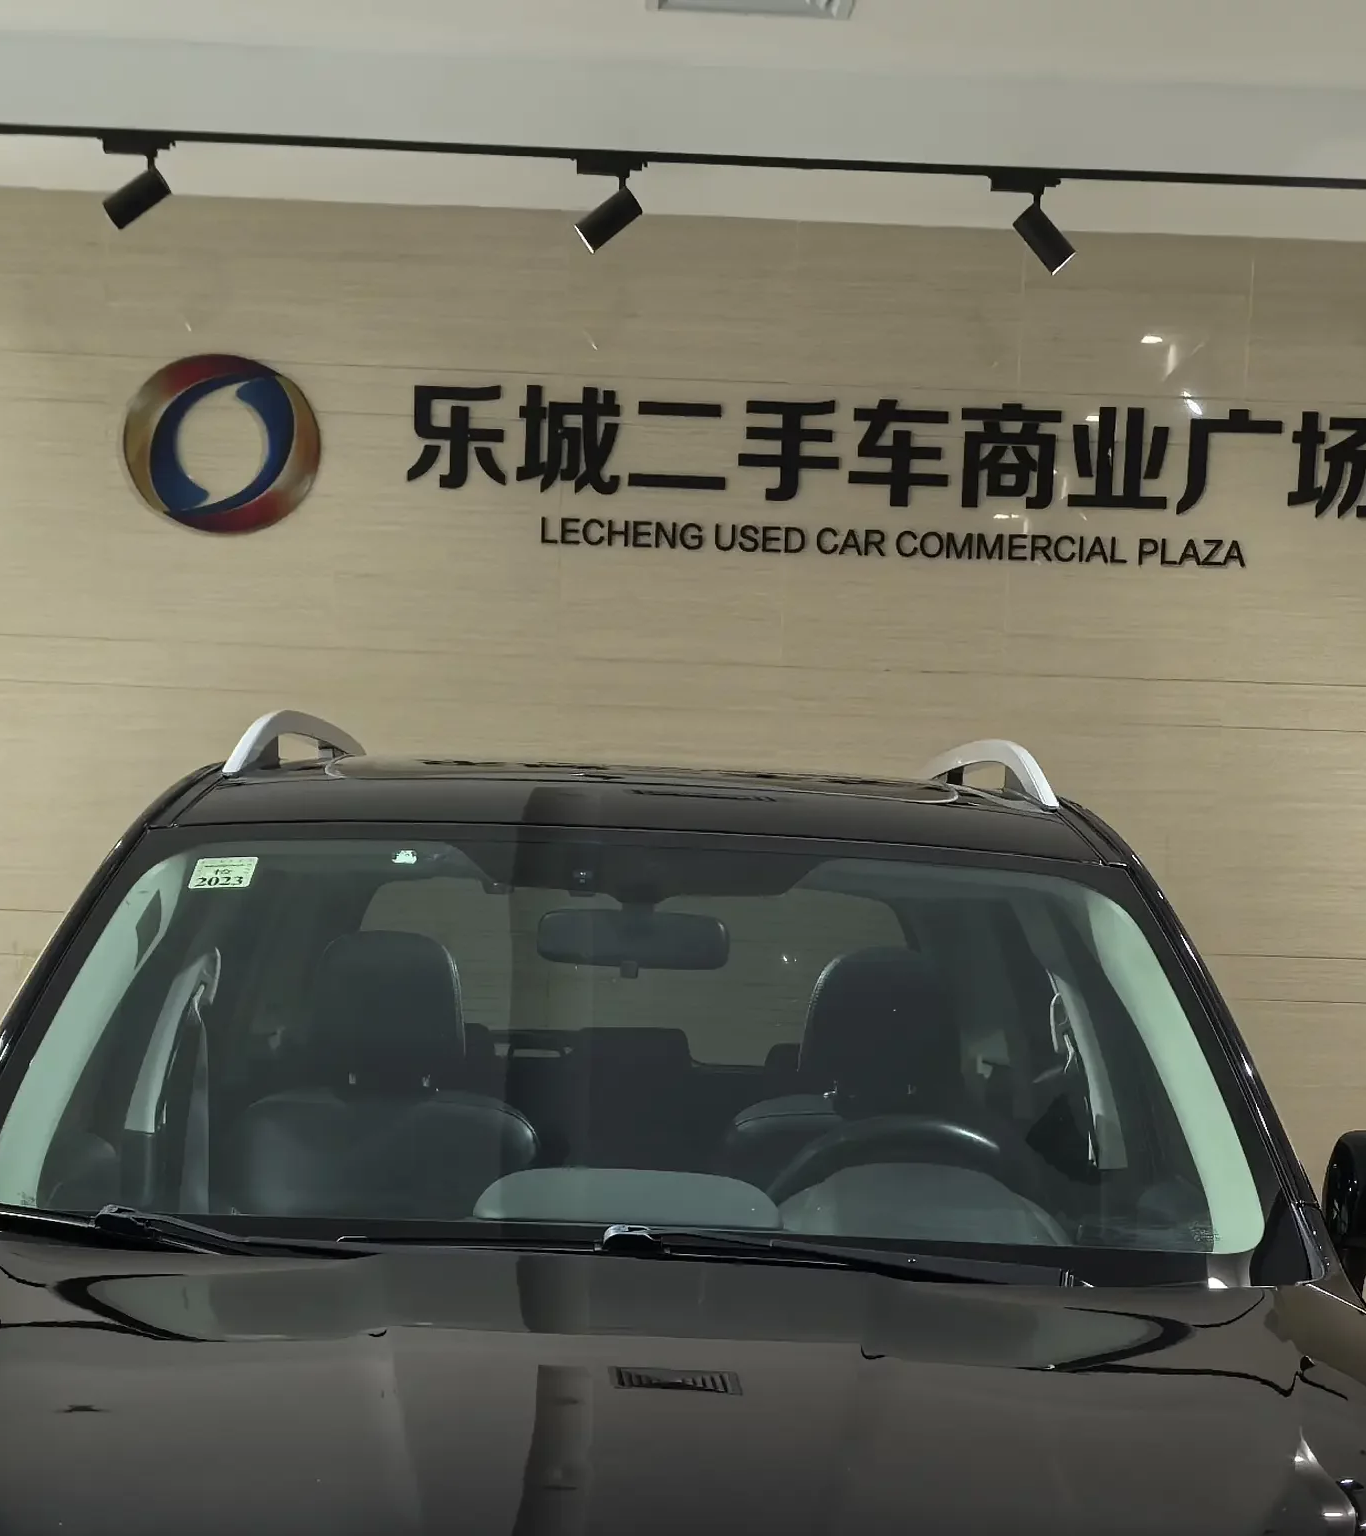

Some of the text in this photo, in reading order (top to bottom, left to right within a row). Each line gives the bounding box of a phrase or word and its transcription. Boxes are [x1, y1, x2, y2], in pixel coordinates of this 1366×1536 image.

[539, 516, 1247, 569] LECHENG USED CAR COMMERCIAL PLAZA
[194, 876, 244, 887] 2023
